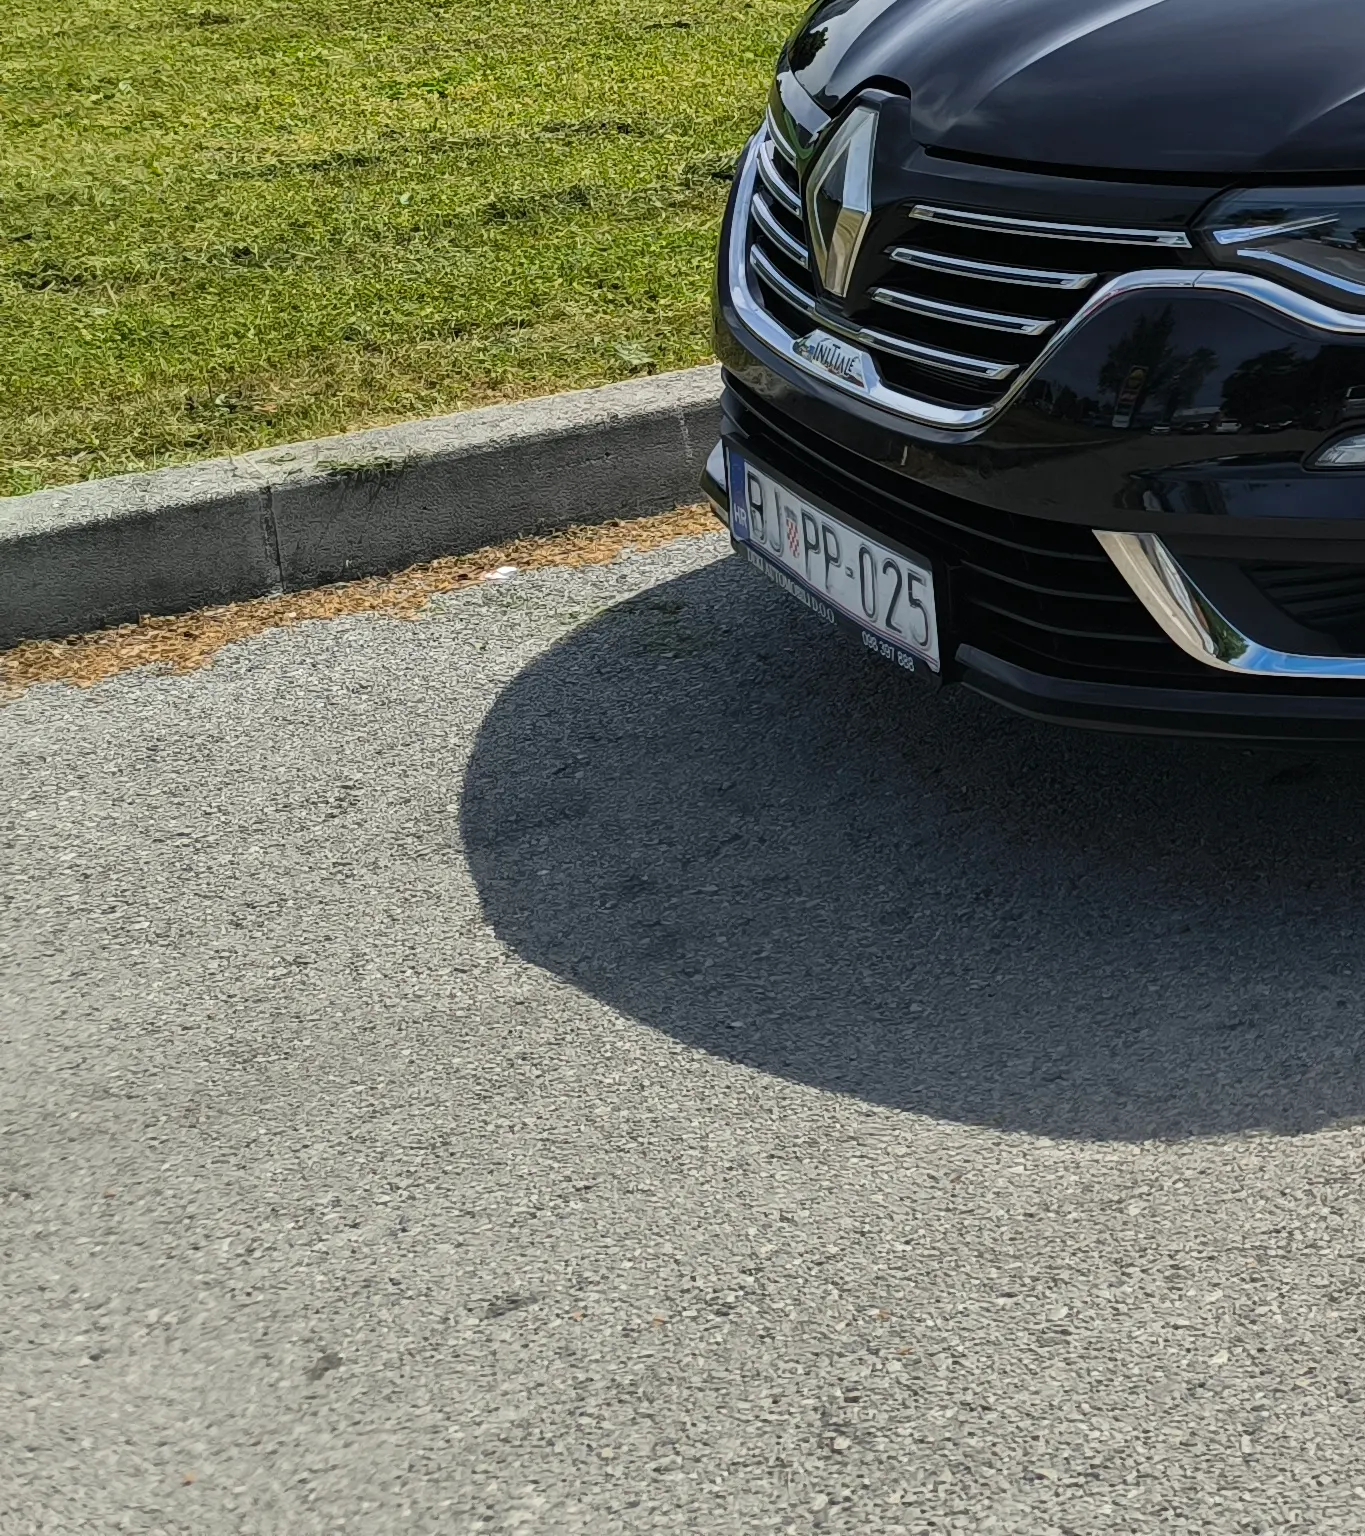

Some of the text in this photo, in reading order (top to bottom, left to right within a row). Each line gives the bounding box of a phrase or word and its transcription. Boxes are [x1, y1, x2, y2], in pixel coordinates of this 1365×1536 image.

[733, 501, 748, 529] HR
[746, 469, 931, 649] BJ PP-025
